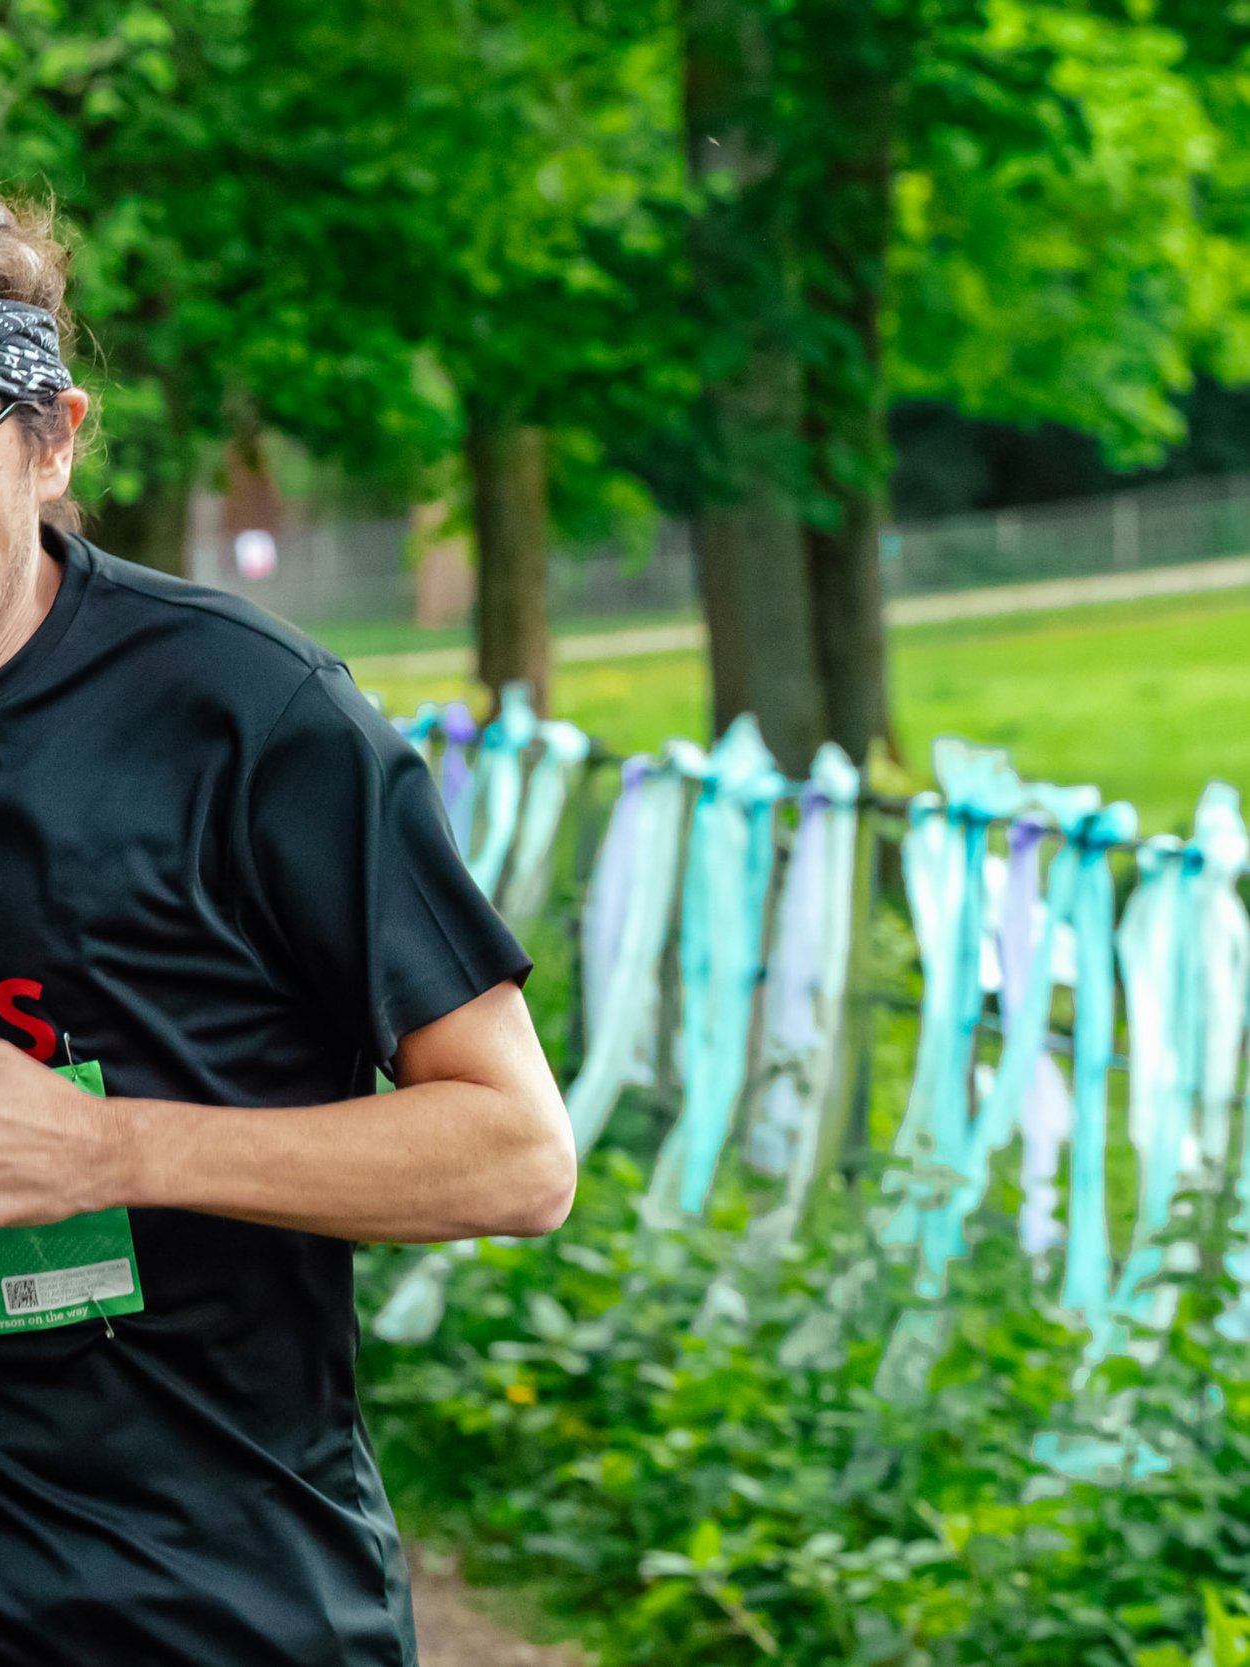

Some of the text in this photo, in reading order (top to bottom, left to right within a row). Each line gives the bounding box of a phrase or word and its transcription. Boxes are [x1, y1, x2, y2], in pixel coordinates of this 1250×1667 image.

[28, 1315, 43, 1326] on
[45, 1311, 66, 1325] the
[67, 1305, 89, 1319] way
